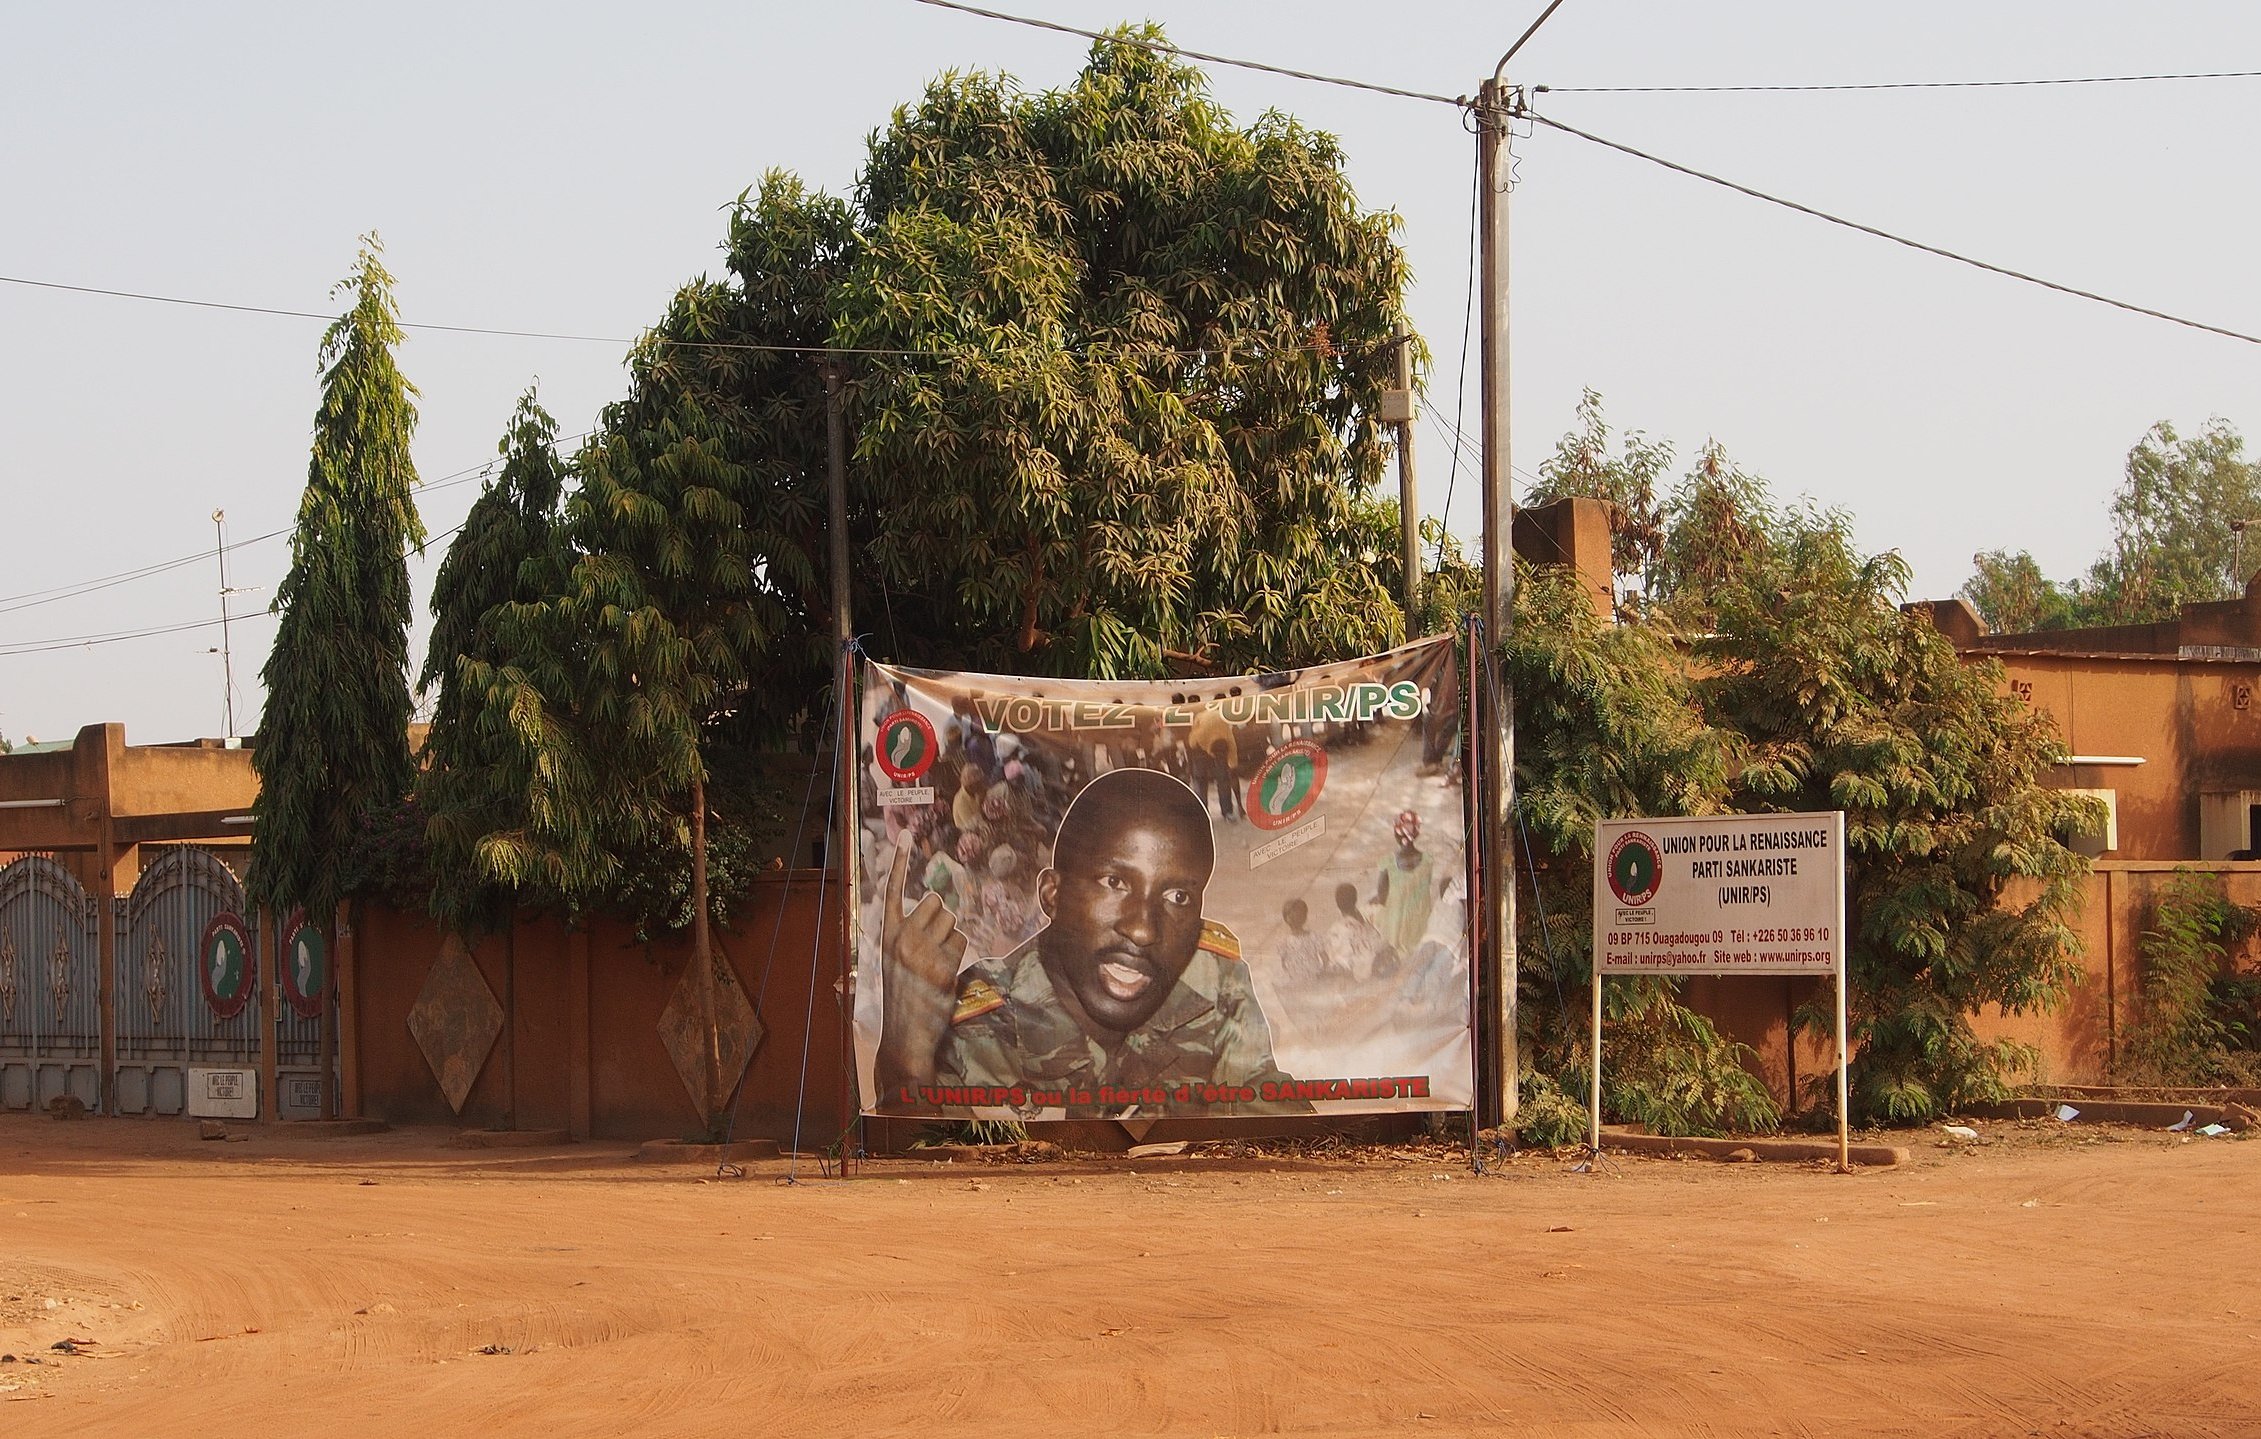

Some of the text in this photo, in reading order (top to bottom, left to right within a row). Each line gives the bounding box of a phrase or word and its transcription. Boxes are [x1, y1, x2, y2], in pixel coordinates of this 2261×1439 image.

[974, 695, 1136, 734] VOTEZ
[893, 771, 916, 779] UNIR/PS
[1252, 765, 1266, 785] UNION
[1265, 750, 1280, 765] POUR
[1272, 808, 1302, 826] UNIR/PS
[1253, 844, 1272, 859] AVEC
[1277, 836, 1287, 846] LE
[1266, 841, 1298, 860] VICTOIRE
[1612, 838, 1624, 854] POUR
[1615, 838, 1651, 858] PARTI SANKARISTE
[1663, 830, 1827, 854] UNION POUR LA RENAISSANCE
[1692, 858, 1797, 878] PARTI SANKARISTE
[1718, 885, 1771, 909] (UNIR/PS)
[1607, 933, 1619, 945] 09
[1621, 932, 1633, 945] BP
[1635, 931, 1650, 945] 715
[1652, 931, 1710, 948] Ouagadougou
[1712, 930, 1723, 943] 09
[1730, 929, 1745, 943] Tél
[1753, 928, 1774, 942] +226
[1777, 928, 1788, 941] 50
[1790, 928, 1801, 941] 36
[1804, 928, 1815, 941] 96
[1818, 927, 1829, 941] 10
[1606, 951, 1633, 965] E-mail
[1639, 951, 1707, 967] unirps@yahoo.fr
[1714, 950, 1731, 963] Site
[1733, 949, 1751, 963] web
[1759, 949, 1831, 966] www.unirps.org
[1031, 1089, 1062, 1105] ou
[1070, 1087, 1092, 1105] la
[1260, 1076, 1430, 1102] SANKARISTE
